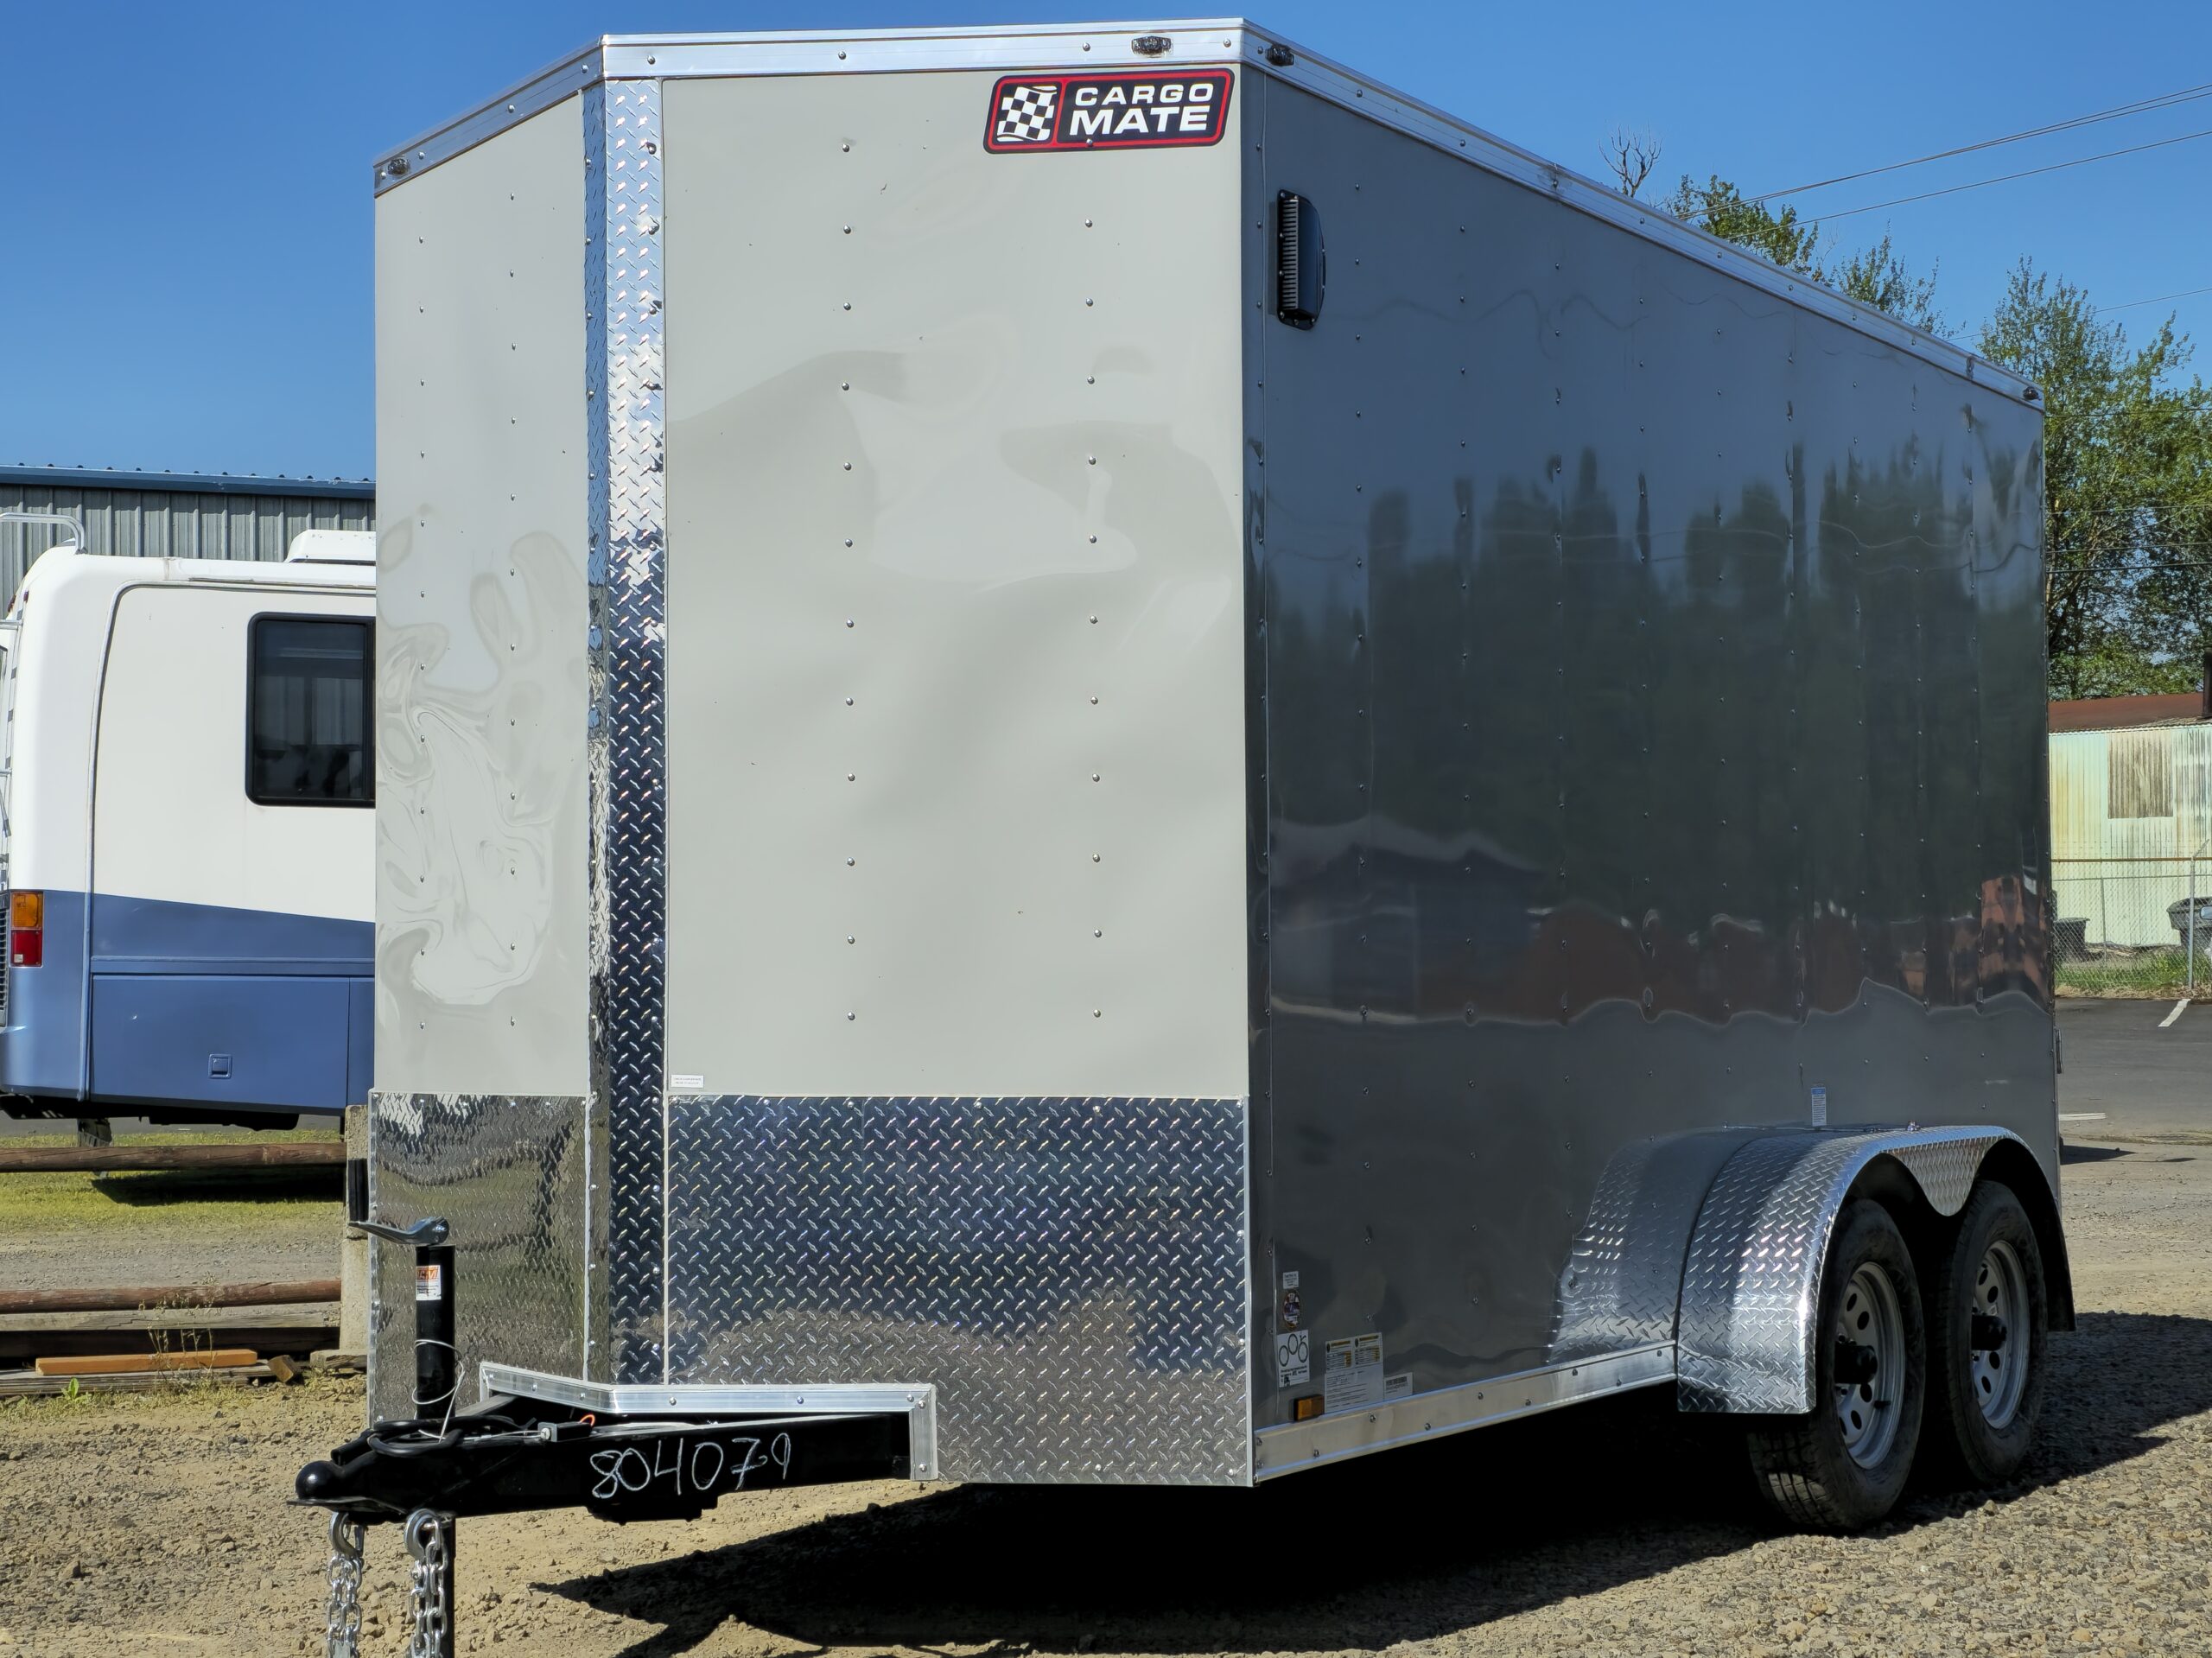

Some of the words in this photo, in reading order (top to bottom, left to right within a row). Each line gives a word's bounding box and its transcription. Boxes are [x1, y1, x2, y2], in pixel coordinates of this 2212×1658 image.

[1075, 83, 1214, 106] CARGO
[1069, 105, 1211, 136] MATE
[589, 1432, 791, 1499] 804079
